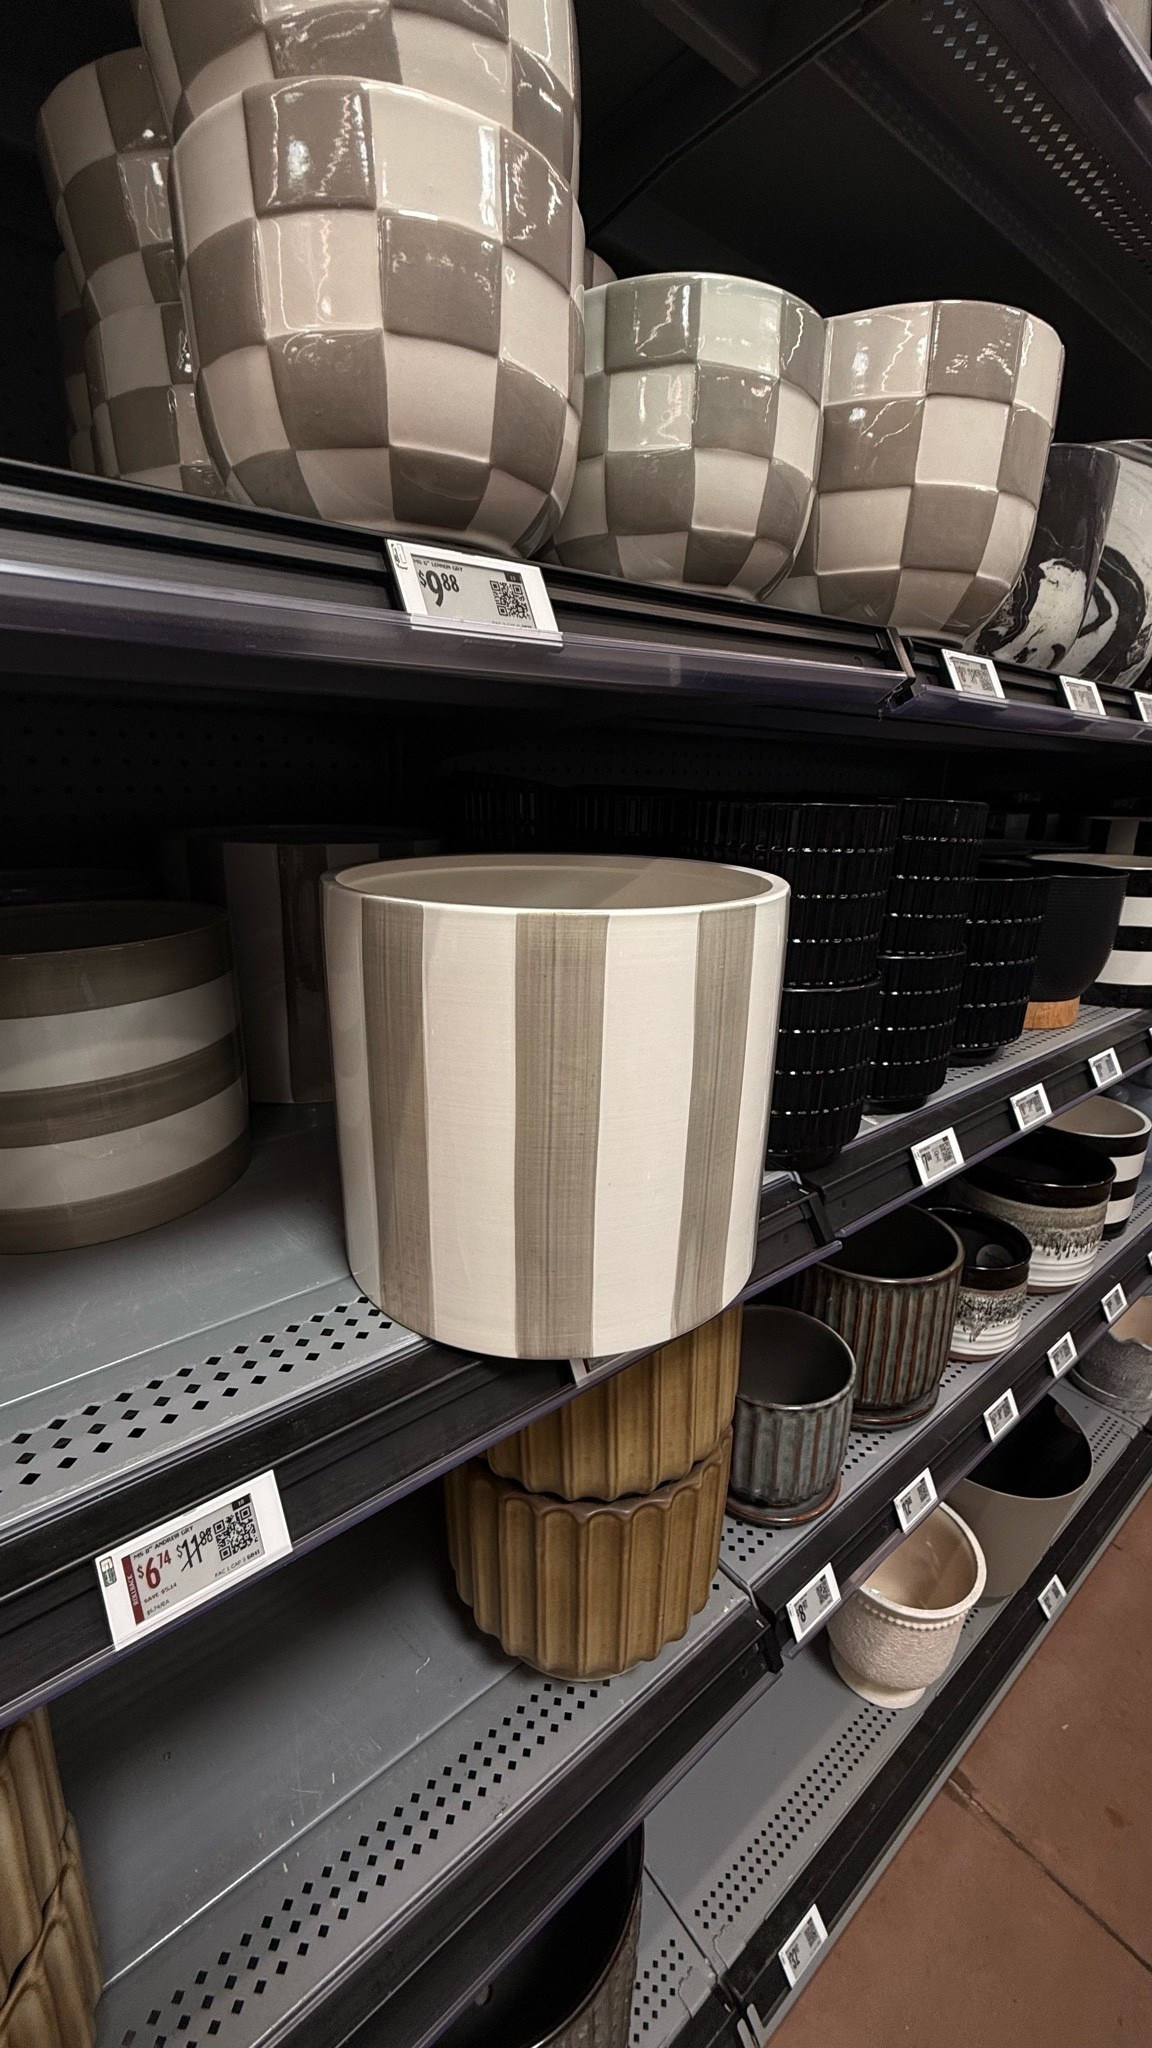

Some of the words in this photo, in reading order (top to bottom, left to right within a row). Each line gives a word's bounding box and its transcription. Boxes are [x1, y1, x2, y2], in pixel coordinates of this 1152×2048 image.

[155, 1532, 180, 1549] ANDREW
[180, 1526, 193, 1536] GRY
[144, 1591, 160, 1604] SAVE
